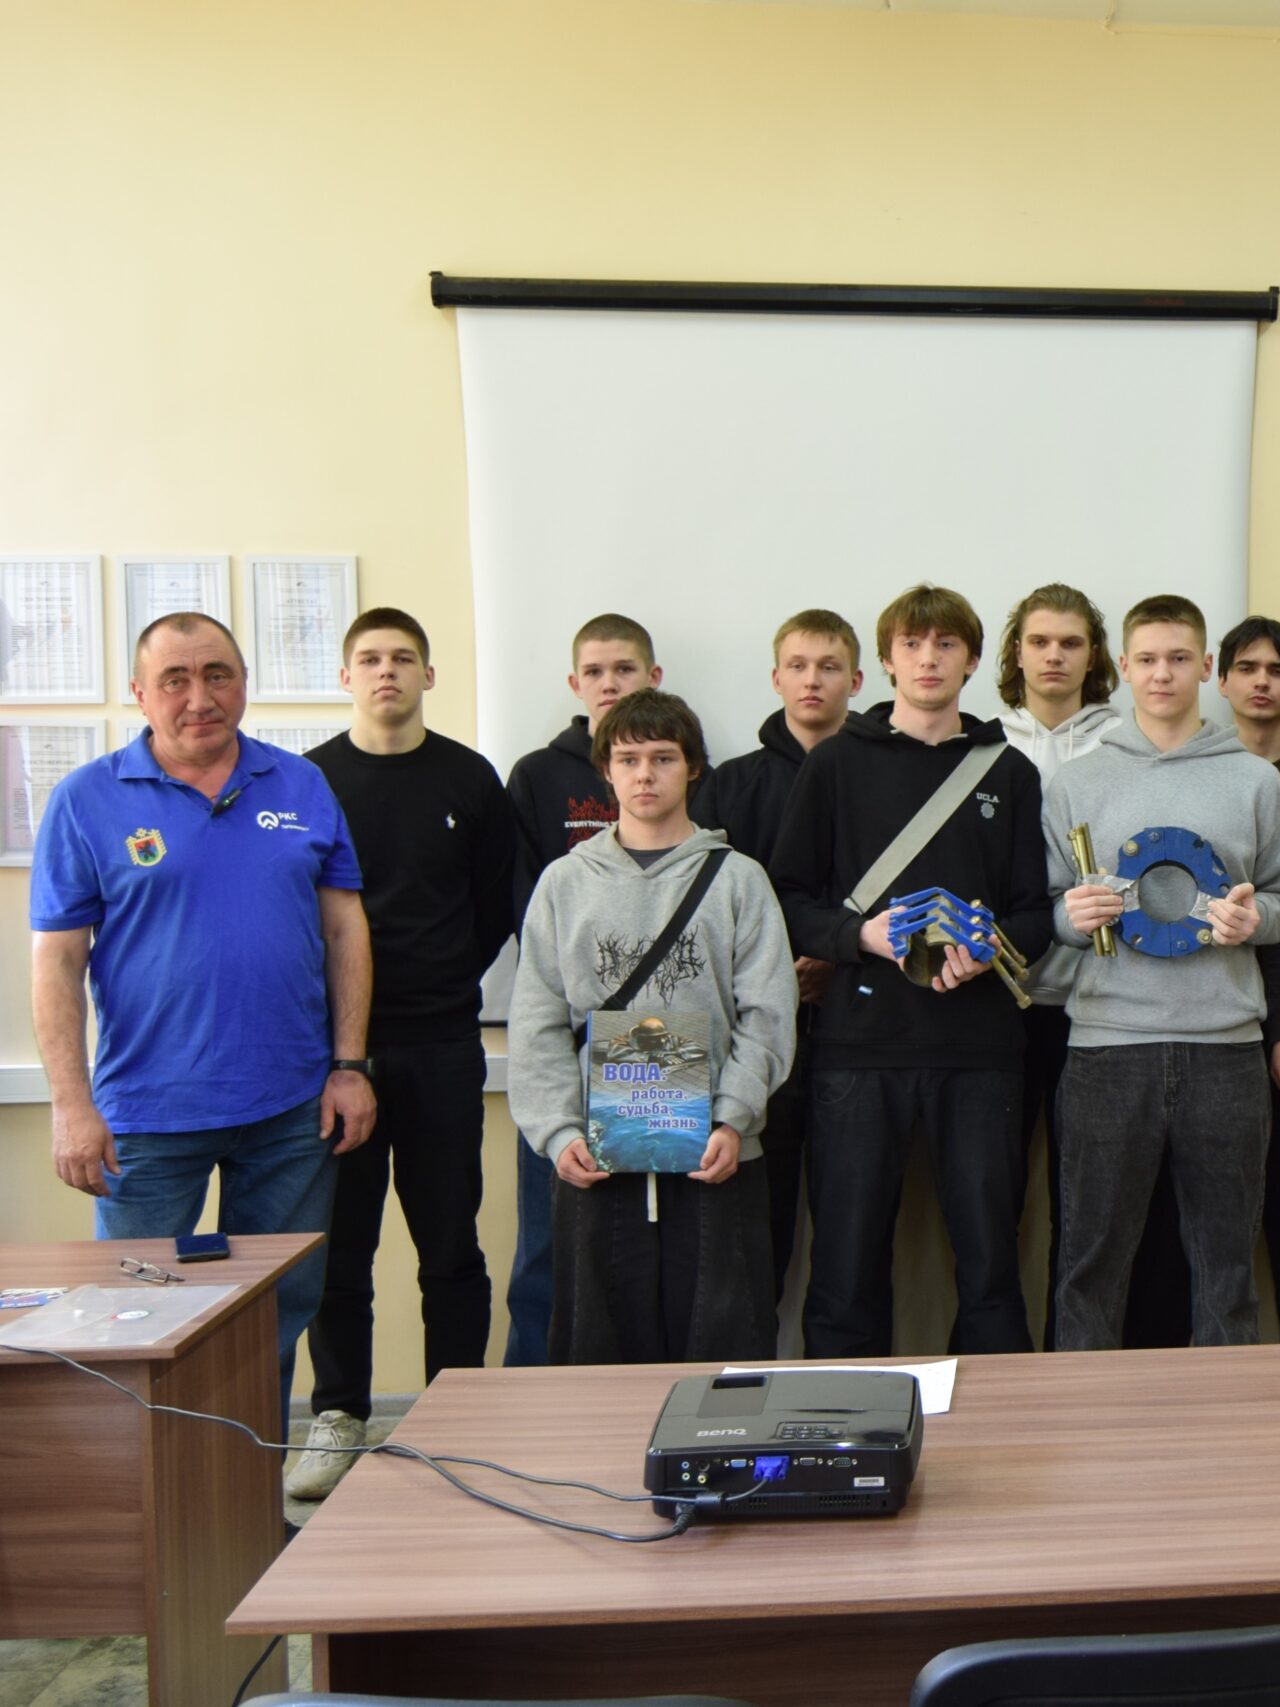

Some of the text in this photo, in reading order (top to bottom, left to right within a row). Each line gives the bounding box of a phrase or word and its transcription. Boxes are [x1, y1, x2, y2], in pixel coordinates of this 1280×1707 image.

[976, 792, 1000, 804] UCLA
[603, 1062, 667, 1083] ВОДА:
[631, 1086, 688, 1102] работа,
[617, 1102, 673, 1117] судьба,
[648, 1119, 699, 1130] жизнь
